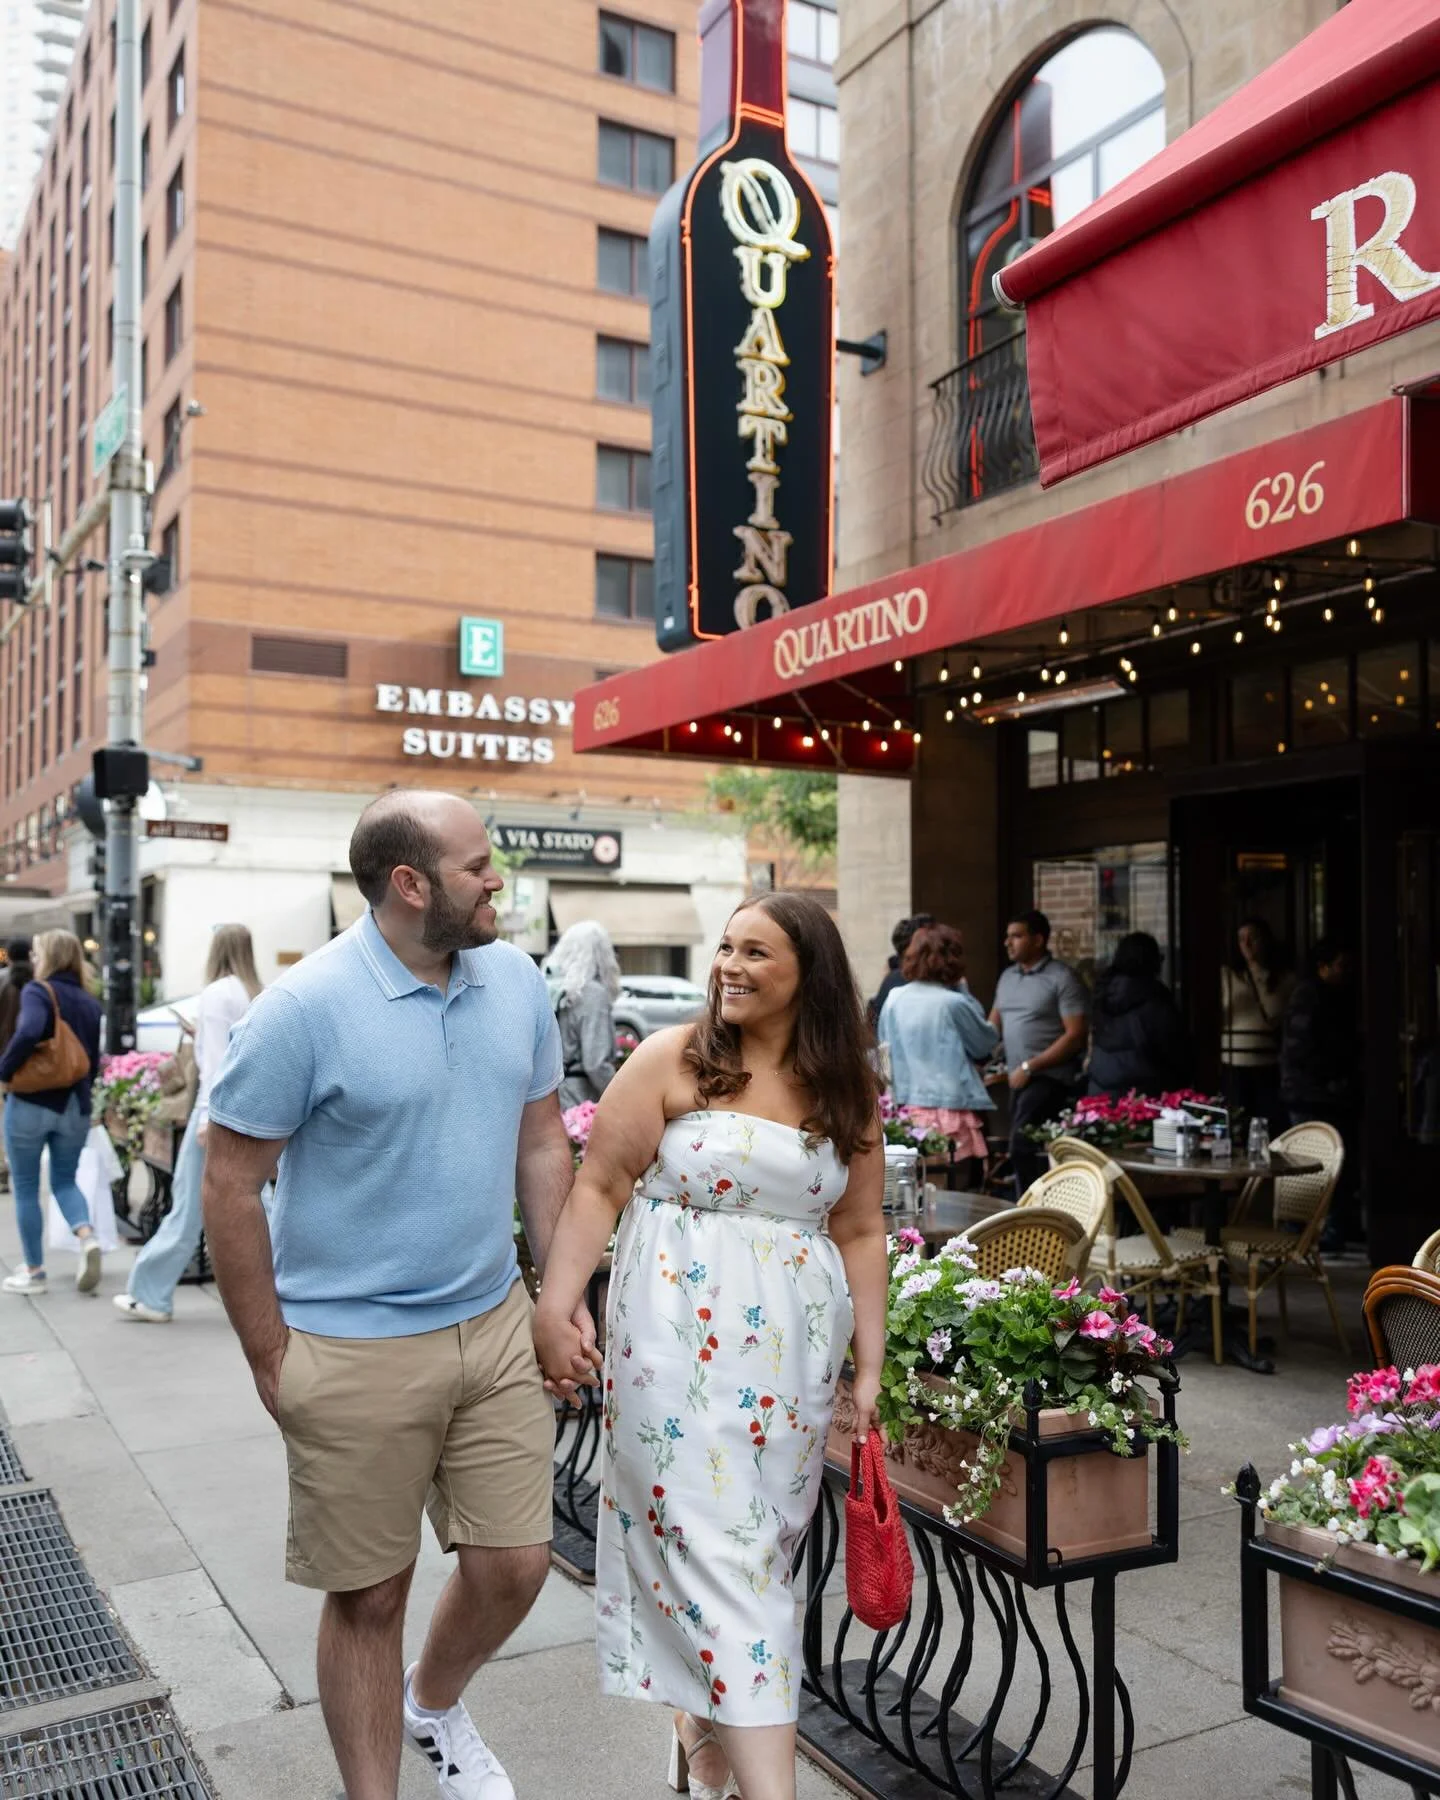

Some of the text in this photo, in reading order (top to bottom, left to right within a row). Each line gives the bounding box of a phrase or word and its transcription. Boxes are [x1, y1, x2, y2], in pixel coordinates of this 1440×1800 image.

[1310, 170, 1440, 341] R
[719, 157, 812, 632] QUARTINO
[1245, 460, 1326, 530] 626
[469, 625, 495, 668] E
[773, 587, 929, 680] QUARTINO
[375, 683, 574, 728] EMBASSY
[593, 695, 621, 732] 626
[402, 727, 555, 765] SUITES
[506, 829, 540, 849] VIA
